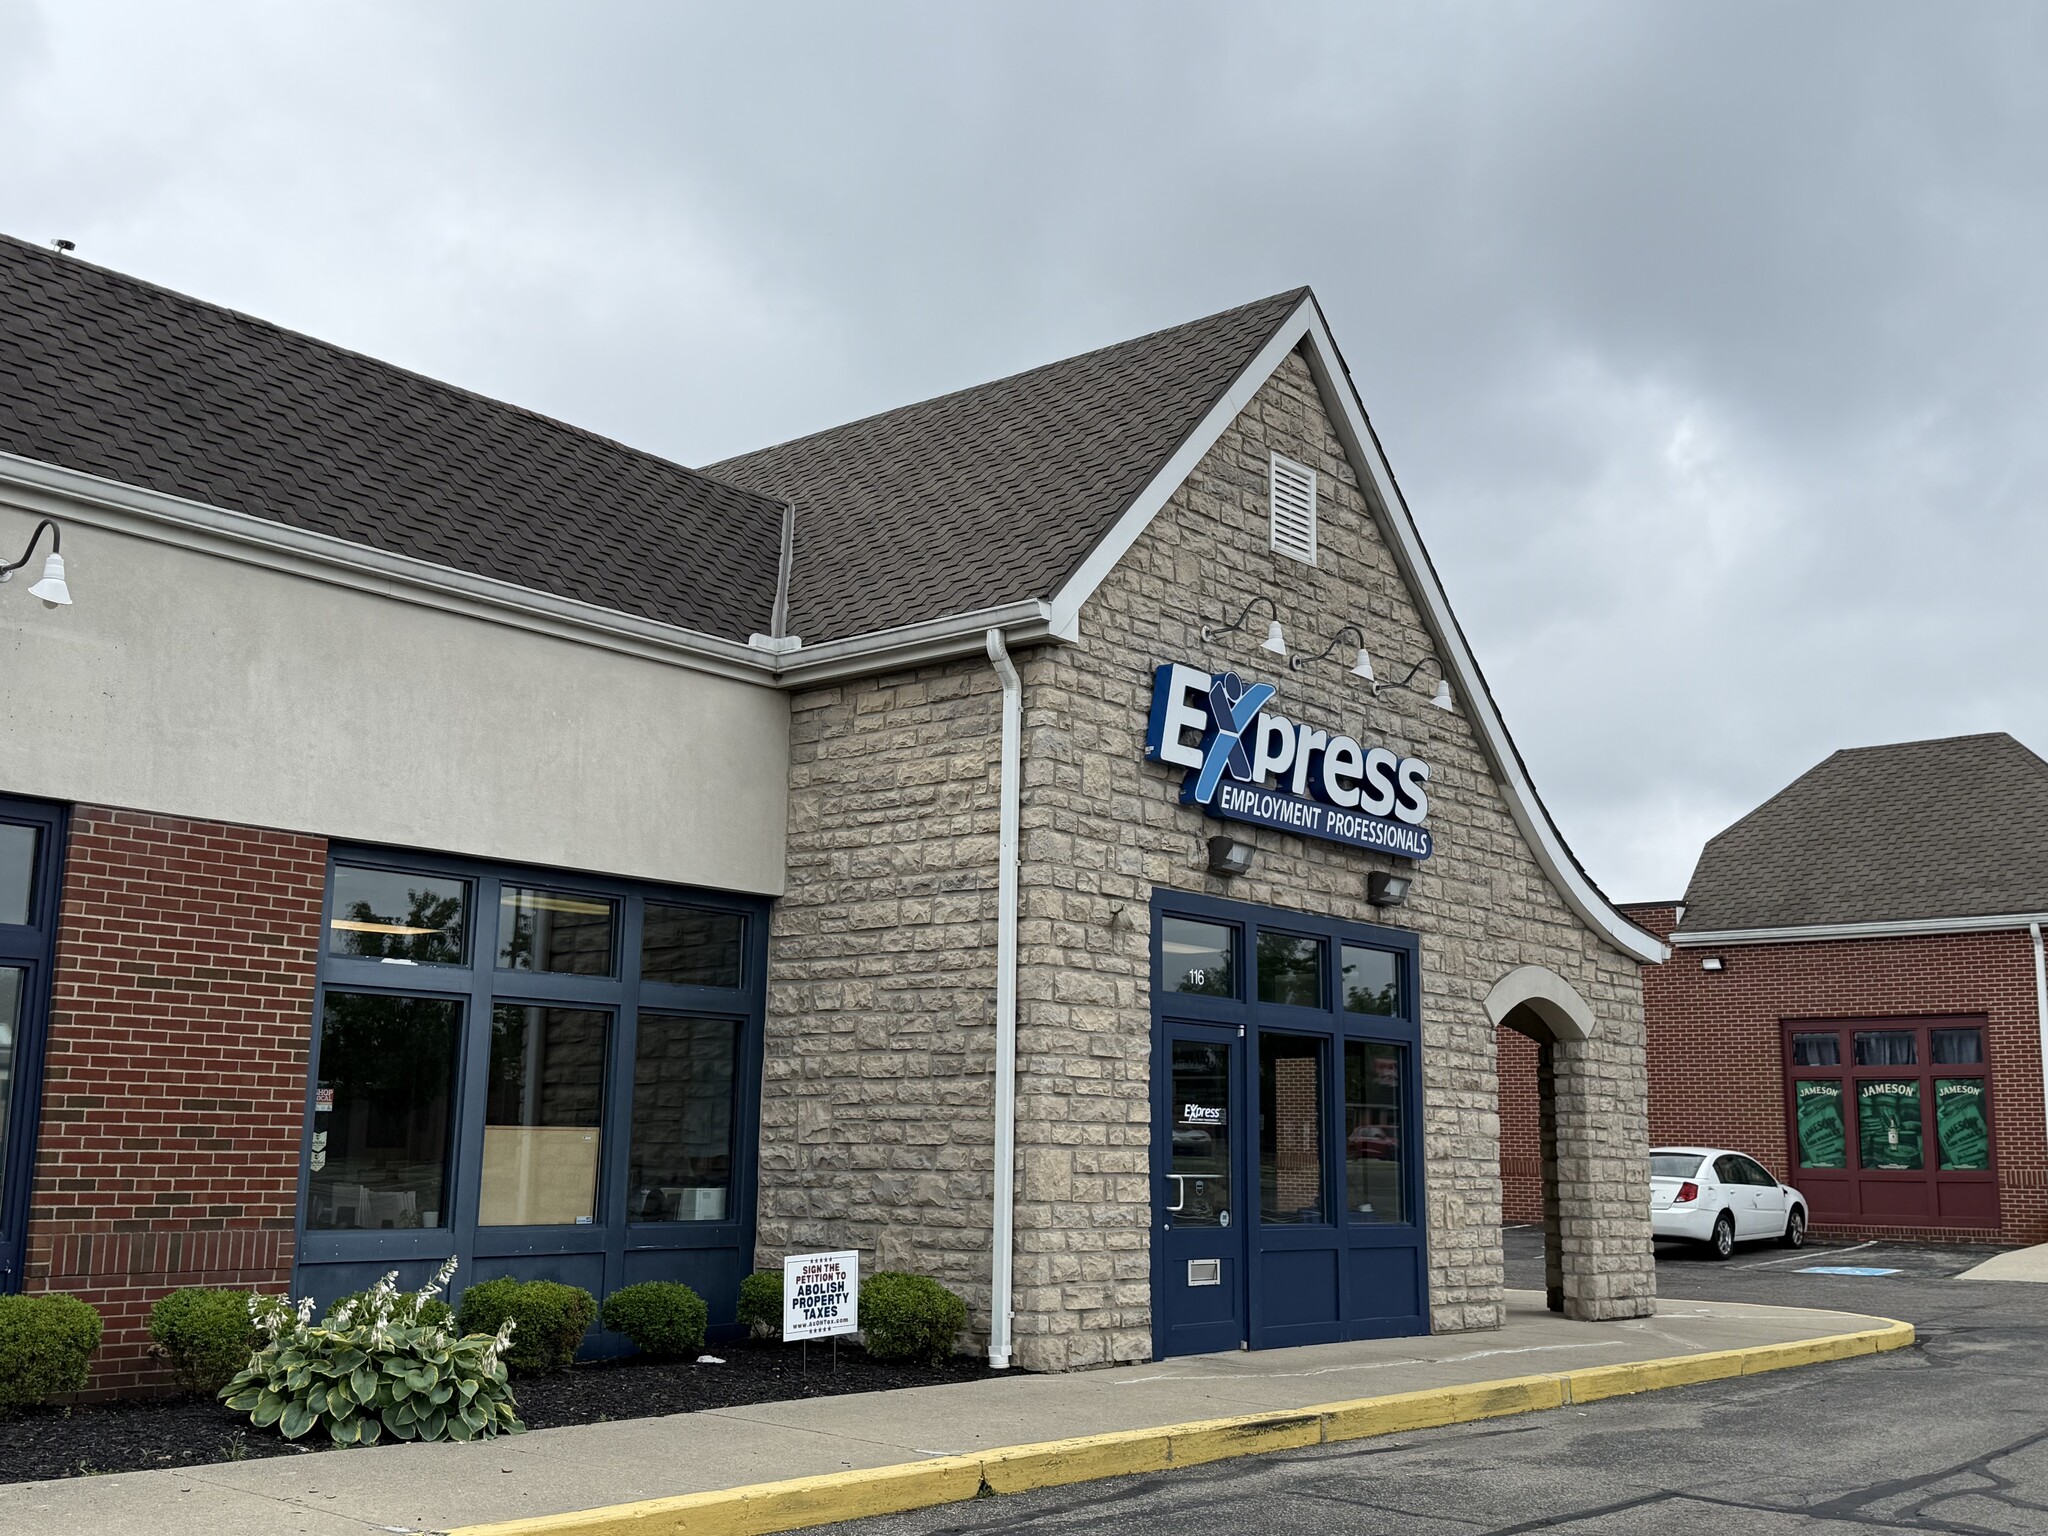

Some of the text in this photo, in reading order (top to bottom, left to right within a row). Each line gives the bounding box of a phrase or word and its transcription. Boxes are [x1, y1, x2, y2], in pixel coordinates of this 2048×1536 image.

[1160, 663, 1431, 824] Express
[1221, 786, 1428, 855] EMPLOYMENT PROFESSIONALS
[1189, 968, 1205, 985] 116
[1800, 1086, 1838, 1097] JAMESON
[1862, 1083, 1914, 1097] JAMESON
[1939, 1085, 1980, 1096] JAMESON
[1184, 1103, 1220, 1121] Express
[803, 1263, 840, 1274] SIGN THE
[796, 1271, 847, 1285] PETITION TO
[797, 1281, 845, 1297] ABOLISH
[792, 1292, 850, 1309] PROPERTY
[803, 1306, 838, 1320] TAXES
